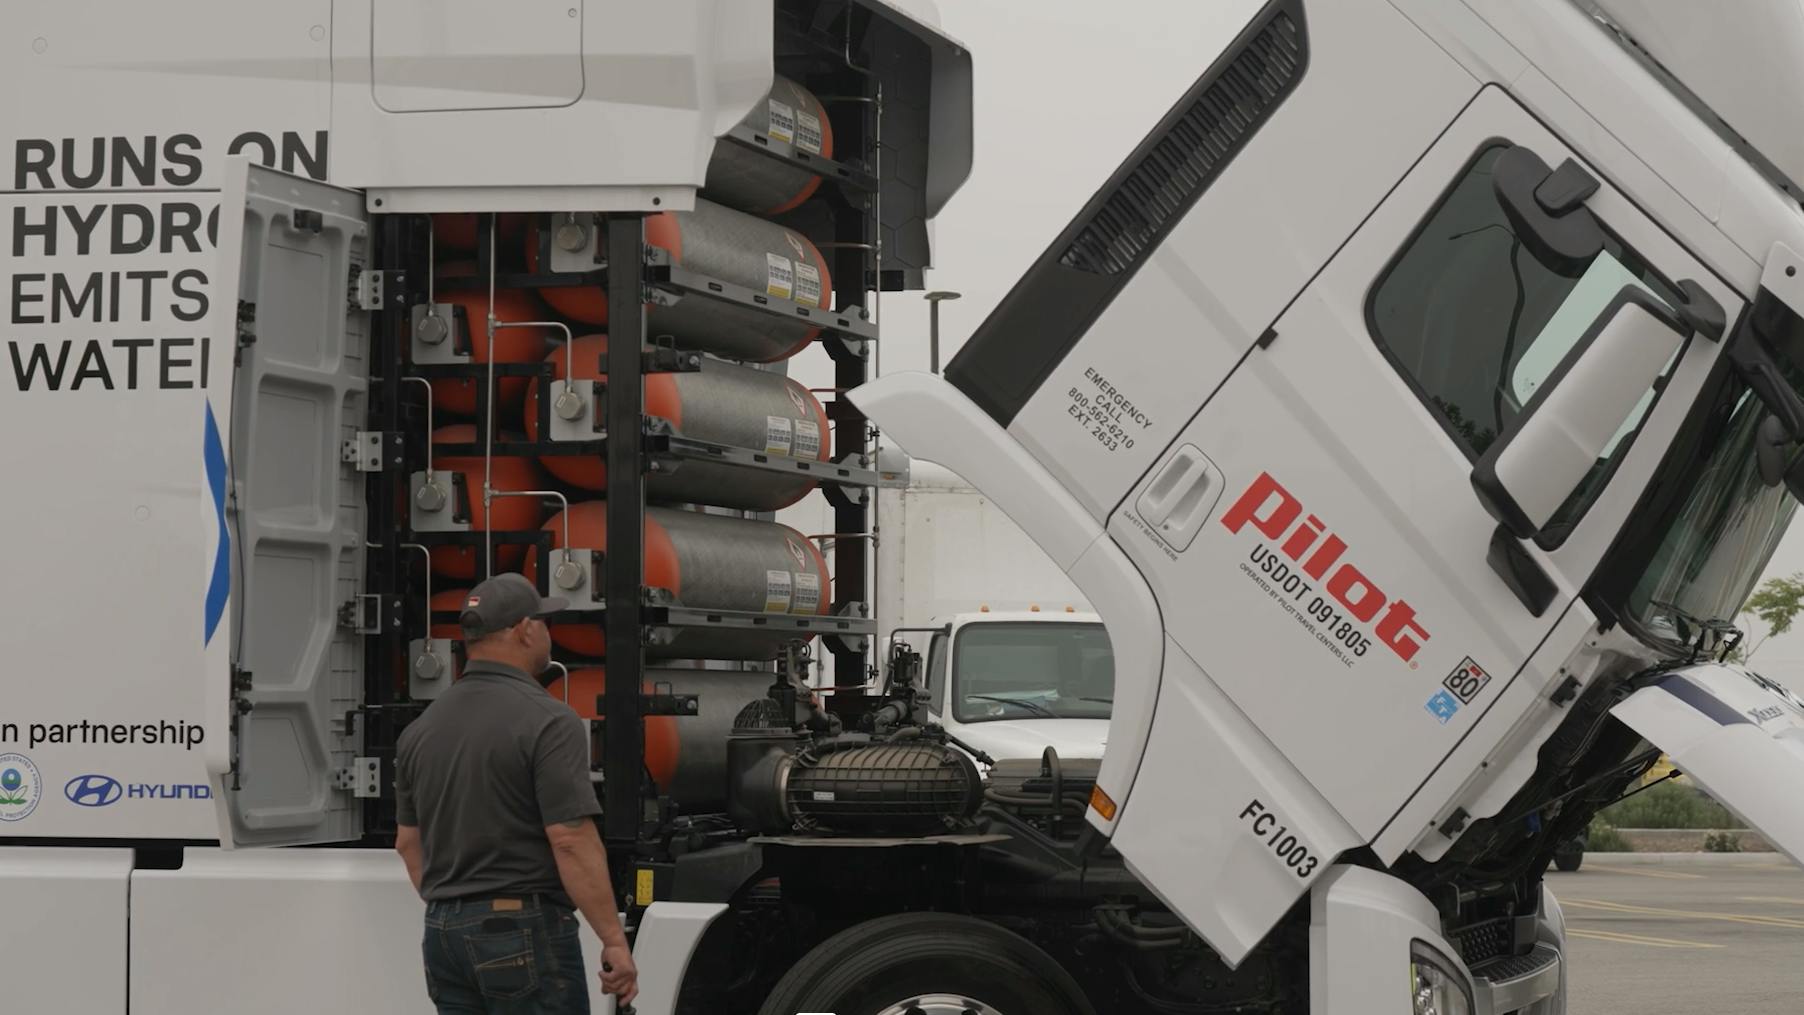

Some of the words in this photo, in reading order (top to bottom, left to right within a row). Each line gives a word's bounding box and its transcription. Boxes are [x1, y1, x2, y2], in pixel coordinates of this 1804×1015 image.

[14, 133, 204, 190] RUNS
[11, 269, 209, 324] EMITS
[1068, 387, 1135, 449] 800-562-6210
[1084, 367, 1153, 429] EMERGENCY
[1095, 394, 1122, 424] CALL
[1068, 404, 1092, 429] EXT.
[1092, 426, 1118, 451] 2633
[1240, 562, 1271, 592] OPERATED
[1268, 588, 1279, 600] BY
[1277, 597, 1296, 615] PILOT
[1294, 611, 1317, 635] TRAVEL
[1315, 632, 1343, 658] CENTERS
[1340, 655, 1355, 669] LLC
[1250, 543, 1312, 601] USDOT
[1307, 597, 1371, 657] 091805
[1450, 668, 1479, 697] 80
[1, 722, 18, 742] n
[29, 720, 204, 750] partnership
[128, 784, 213, 799] HYUND
[1239, 799, 1318, 878] FC1003
